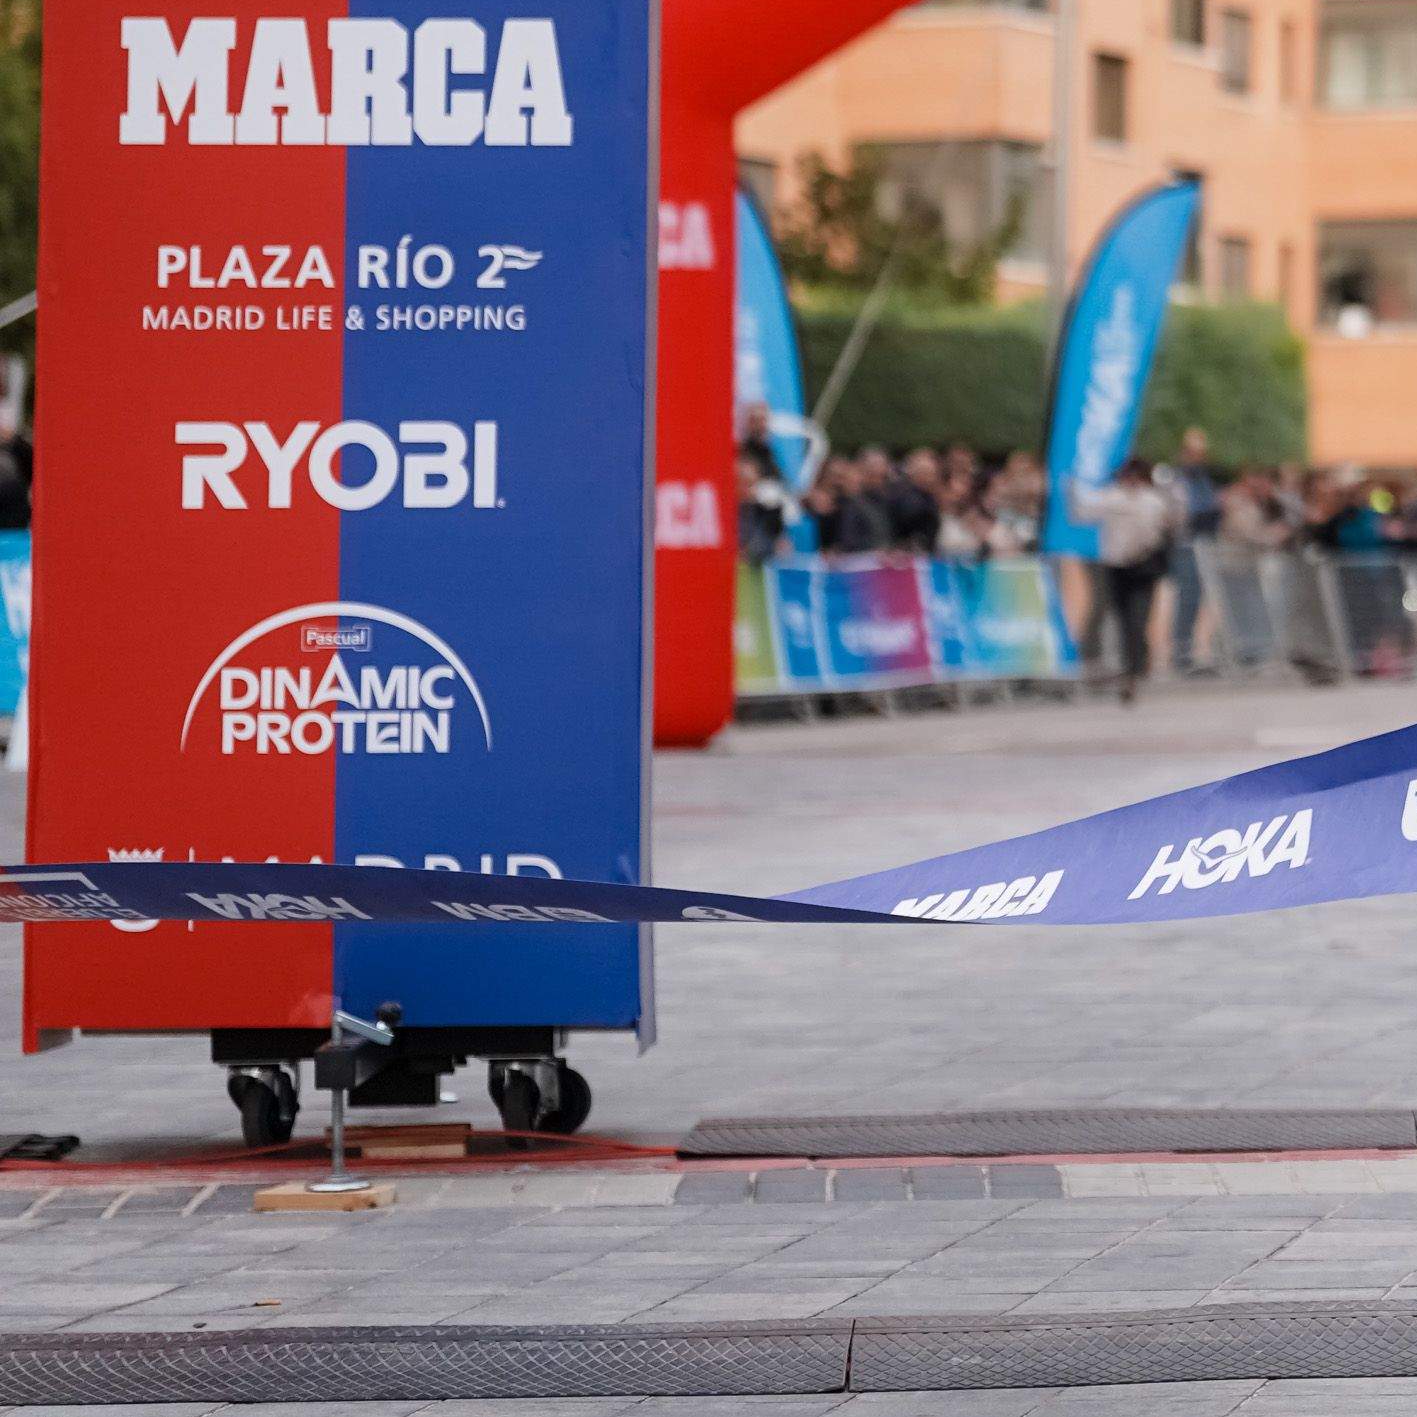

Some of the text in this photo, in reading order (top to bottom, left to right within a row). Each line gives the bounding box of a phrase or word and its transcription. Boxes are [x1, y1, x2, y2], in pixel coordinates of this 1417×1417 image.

[118, 15, 574, 147] MARCA
[157, 234, 520, 290] PLAZA RÍO 2
[142, 305, 526, 332] MADRID LIFE & SHOPPING
[174, 419, 499, 511] RYOBI
[305, 629, 366, 648] Pascual
[221, 711, 450, 754] PROTEIN
[1127, 808, 1313, 901] HOKA
[185, 892, 373, 921] HOKA
